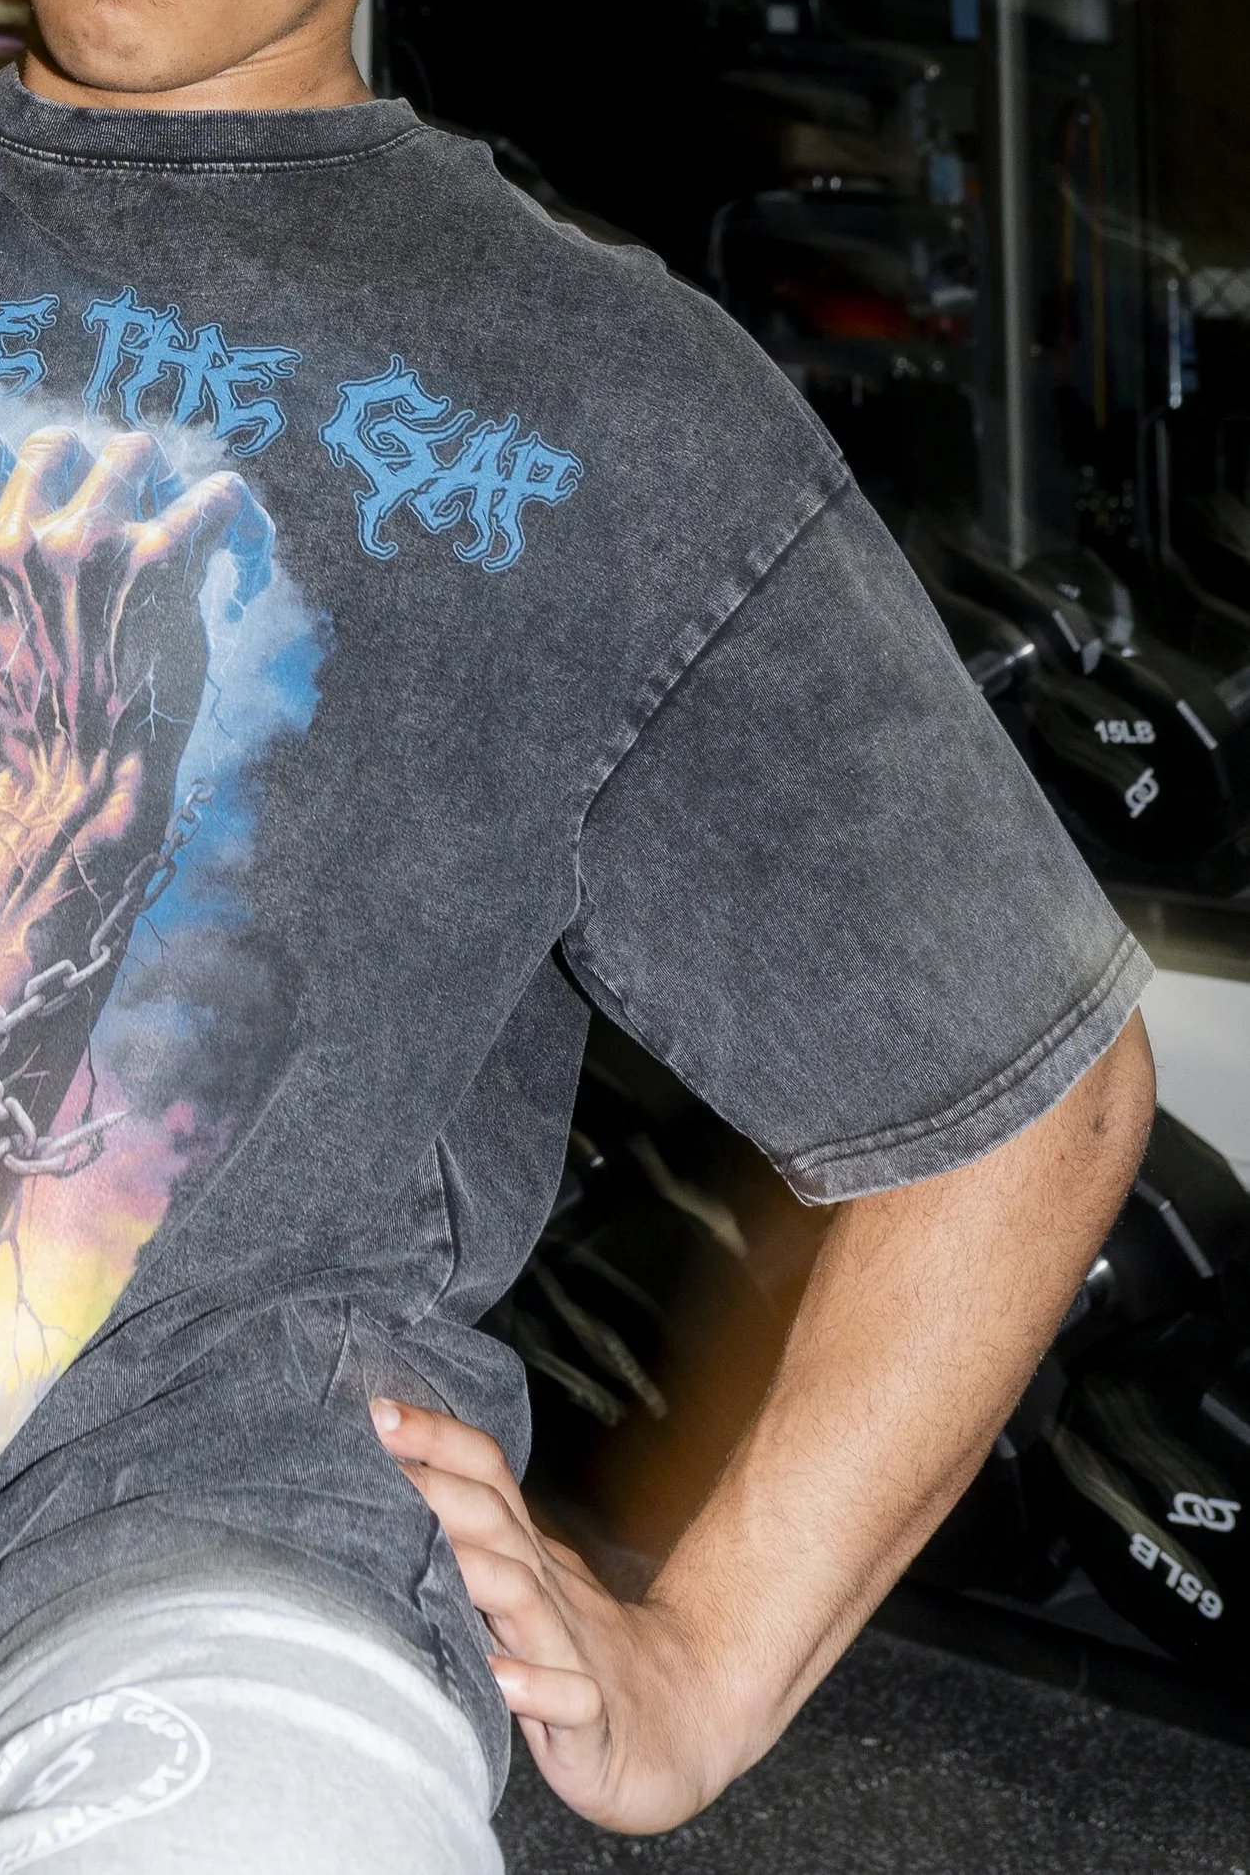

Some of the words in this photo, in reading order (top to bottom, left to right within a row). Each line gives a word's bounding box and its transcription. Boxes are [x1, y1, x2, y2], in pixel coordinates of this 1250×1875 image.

[81, 285, 303, 458] THE
[1094, 719, 1156, 743] 15LB
[1129, 1532, 1223, 1619] 65LB
